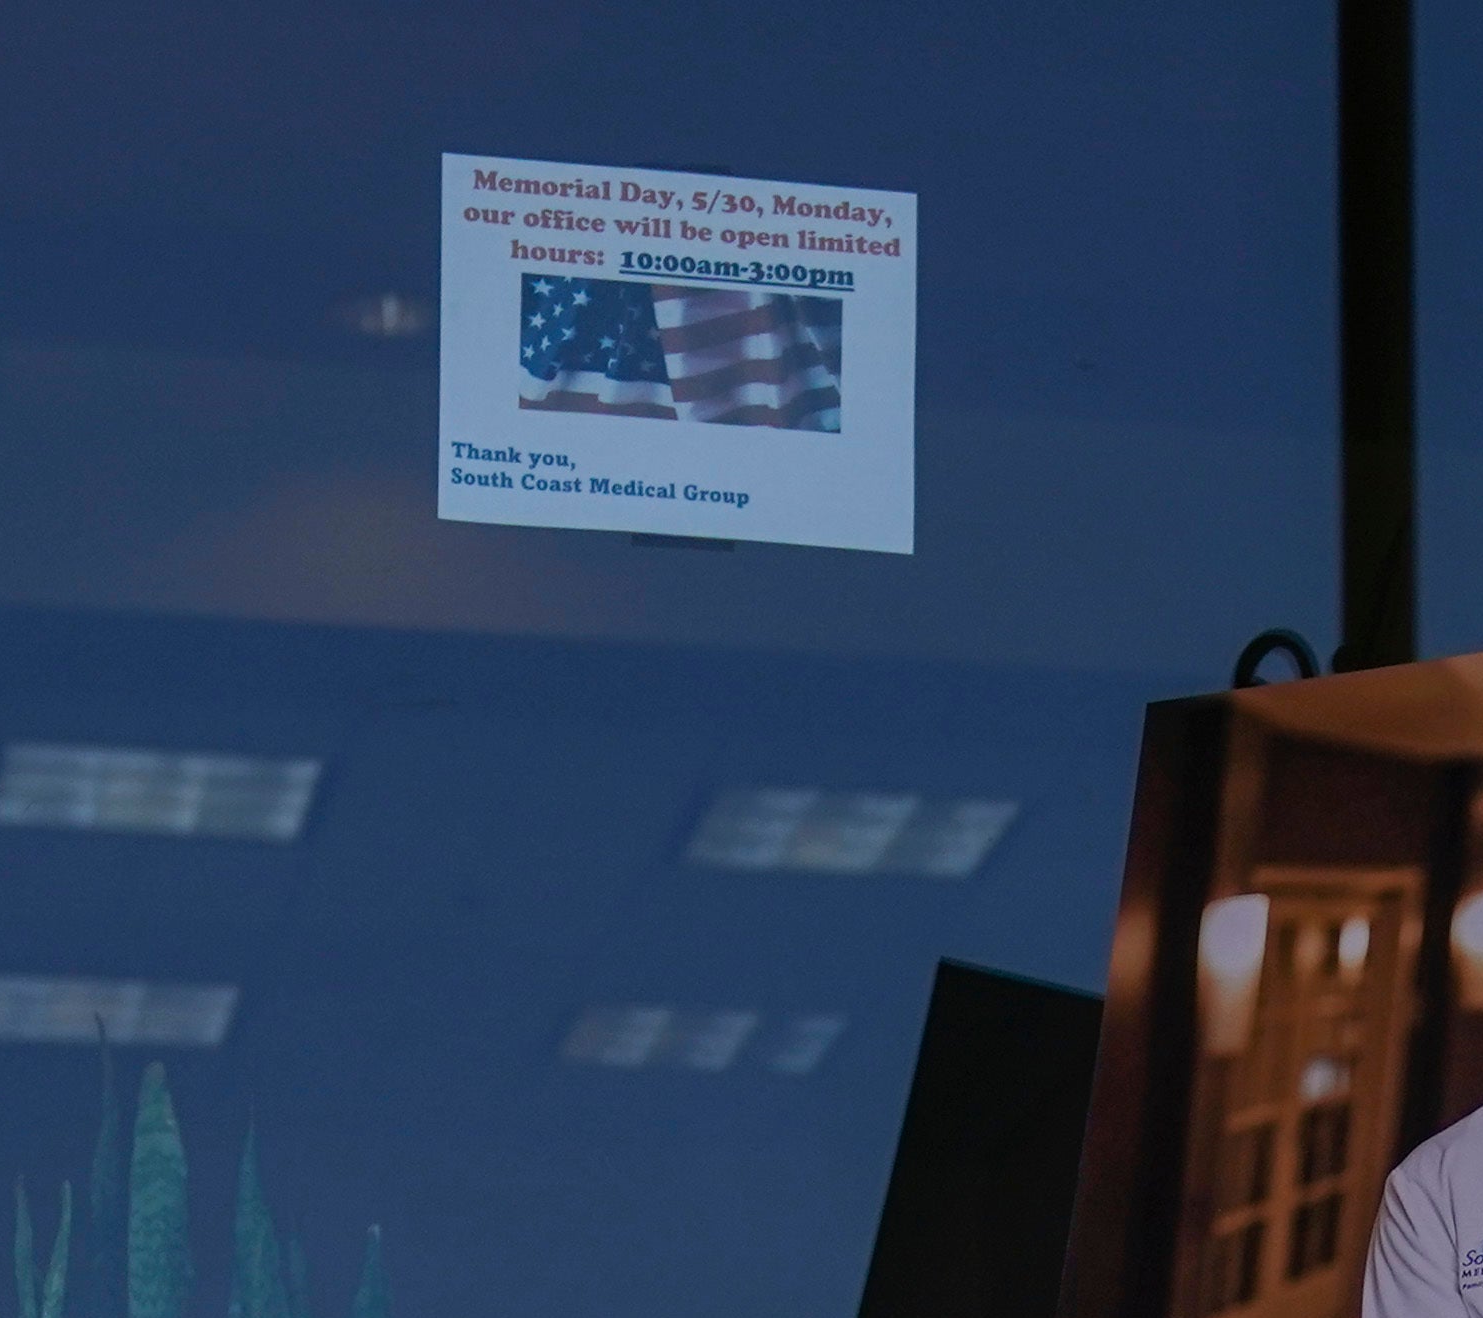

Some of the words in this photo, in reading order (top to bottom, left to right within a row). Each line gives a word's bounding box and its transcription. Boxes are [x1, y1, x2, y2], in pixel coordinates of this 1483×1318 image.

[472, 168, 612, 202] Memorial
[620, 181, 684, 210] Day,
[691, 188, 764, 219] 5/30,
[772, 194, 893, 229] Monday,
[463, 206, 516, 227] our
[523, 209, 607, 234] office
[614, 217, 672, 240] will
[680, 219, 713, 242] be
[720, 228, 790, 252] open
[797, 229, 902, 258] limited
[510, 239, 606, 267] hours:
[619, 248, 855, 290] 10:00am-3:00pm
[451, 440, 522, 465] Thank
[528, 449, 577, 472] you,
[450, 466, 514, 489] South
[520, 474, 583, 495] Coast
[589, 477, 677, 501] Medical
[683, 484, 751, 509] Group
